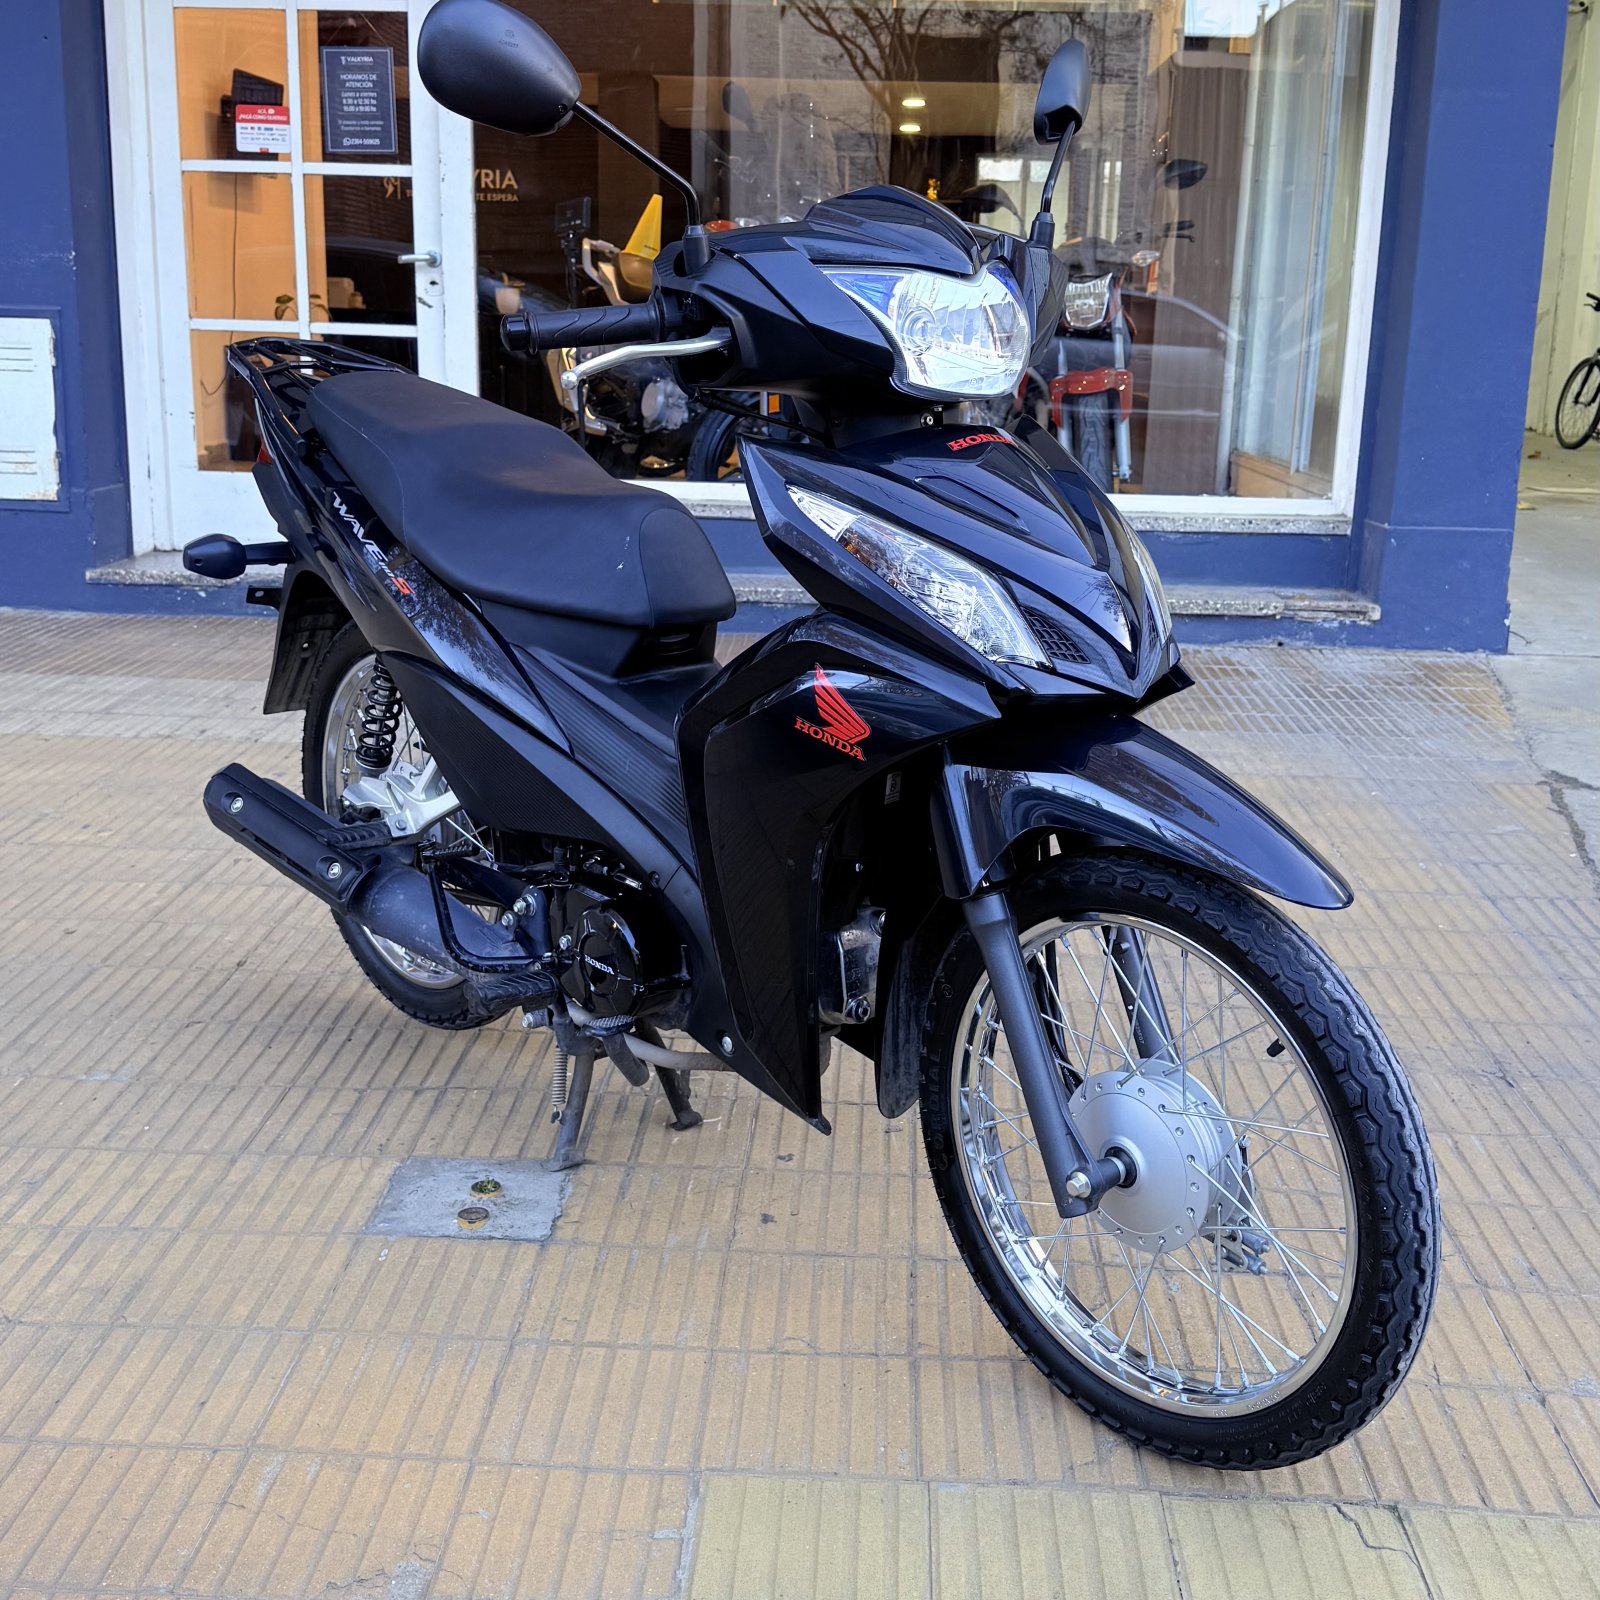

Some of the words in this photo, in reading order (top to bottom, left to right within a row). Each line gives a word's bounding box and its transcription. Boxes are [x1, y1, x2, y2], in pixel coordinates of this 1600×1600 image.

[486, 193, 520, 202] ESPERA
[333, 491, 389, 562] WAVE
[794, 716, 867, 763] HONDA
[584, 954, 615, 975] HONDA
